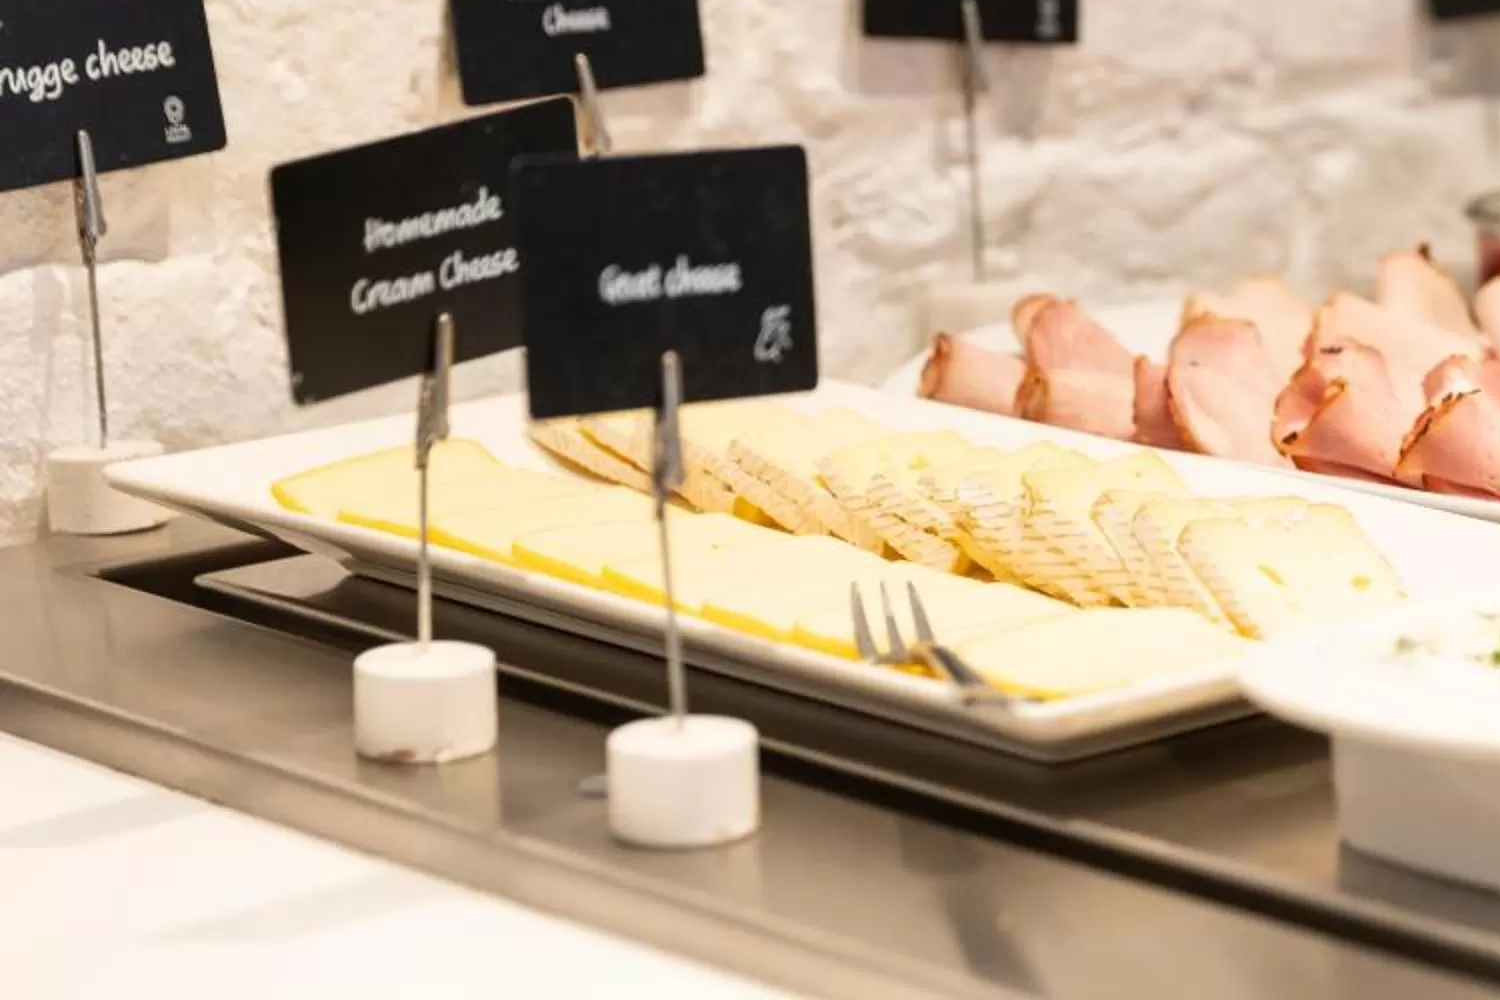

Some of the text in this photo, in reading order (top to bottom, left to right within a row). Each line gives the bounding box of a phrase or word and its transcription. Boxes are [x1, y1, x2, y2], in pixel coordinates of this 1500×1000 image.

[542, 3, 611, 36] Cheese
[85, 38, 176, 80] cheese
[365, 185, 504, 254] Homemade
[352, 248, 520, 315] Cream Cheese
[598, 254, 743, 306] Goat cheese
